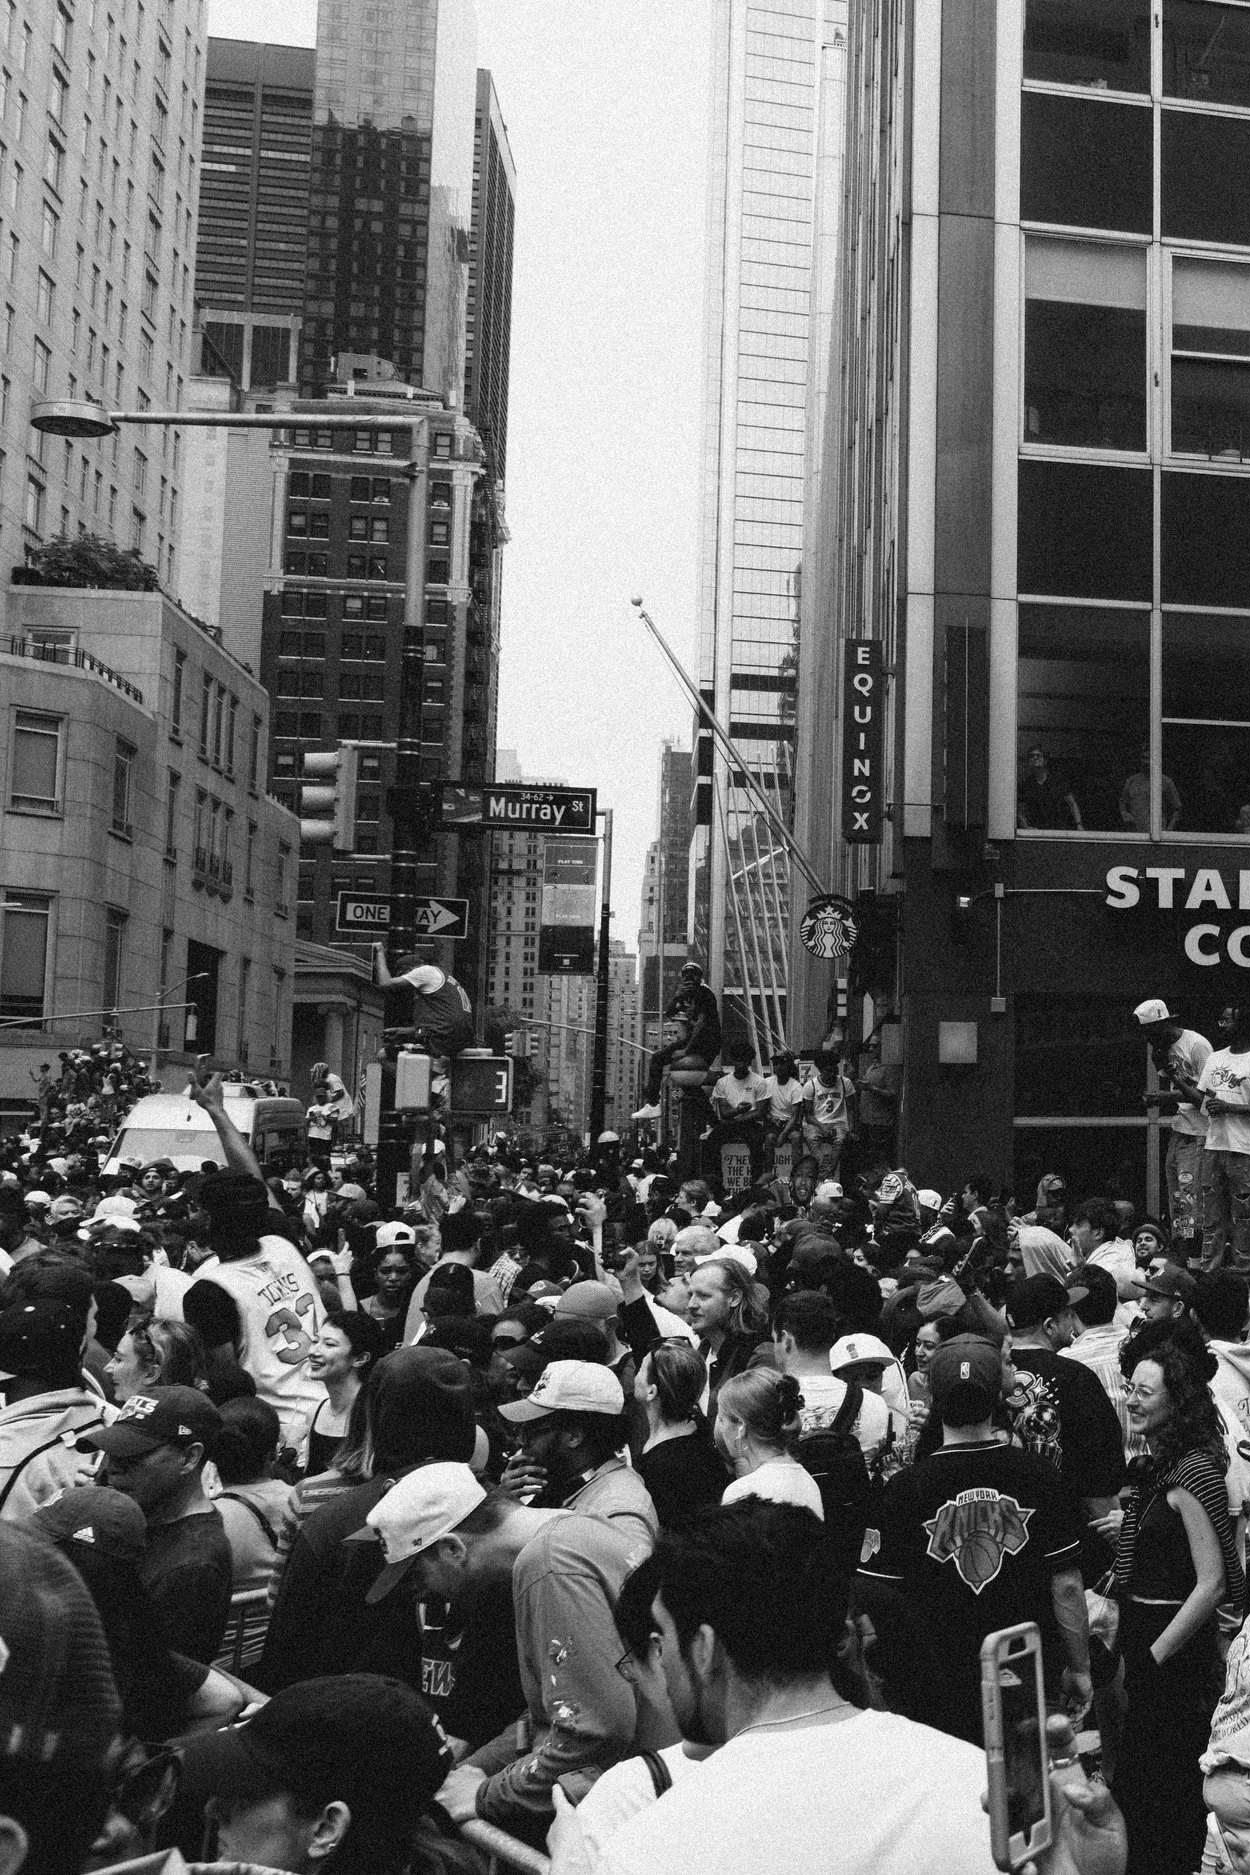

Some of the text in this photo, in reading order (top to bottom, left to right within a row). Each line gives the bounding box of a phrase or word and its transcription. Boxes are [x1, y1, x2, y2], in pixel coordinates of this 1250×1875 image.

[851, 647, 873, 830] EQUINOX
[520, 792, 544, 801] 34-62
[489, 796, 584, 826] Murray St
[353, 904, 442, 924] ONE AY
[494, 1071, 507, 1103] 3
[727, 1166, 745, 1177] THE
[727, 1177, 741, 1188] WE
[956, 1488, 999, 1505] NEW YORK
[929, 1499, 1029, 1560] KNICKS
